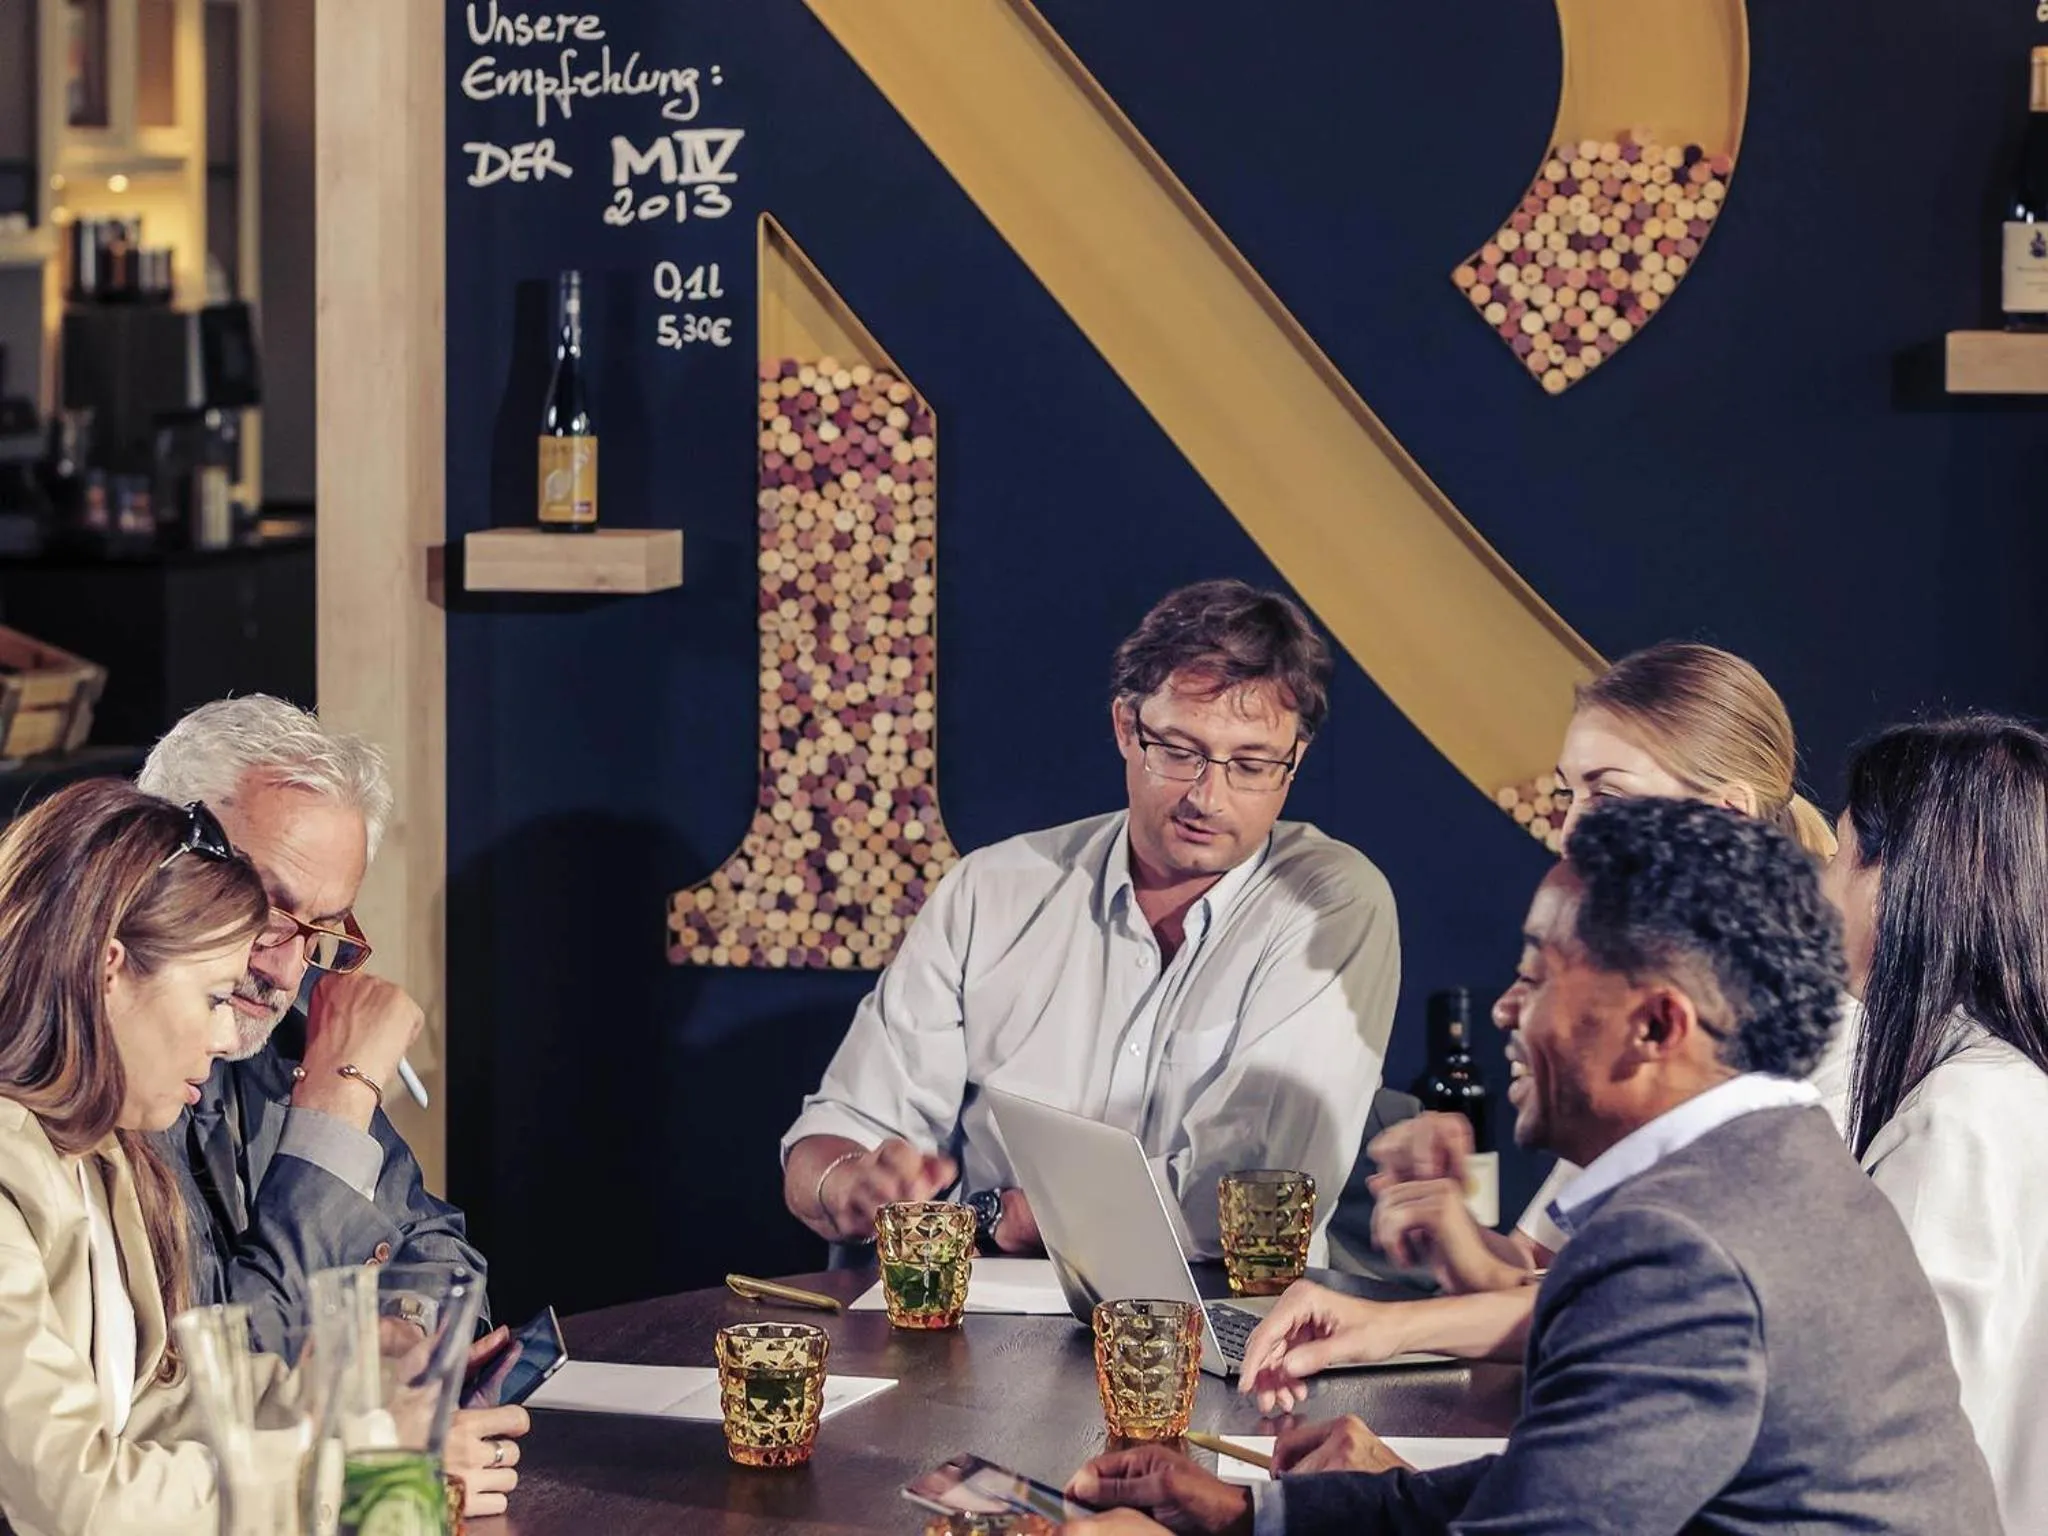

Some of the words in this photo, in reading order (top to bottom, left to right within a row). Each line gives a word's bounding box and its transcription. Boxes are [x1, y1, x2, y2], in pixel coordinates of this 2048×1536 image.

[466, 0, 606, 46] Unsere
[461, 45, 723, 127] Empfehlung:
[462, 138, 573, 187] DER
[603, 184, 733, 226] 2013
[656, 314, 732, 350] 5,30€
